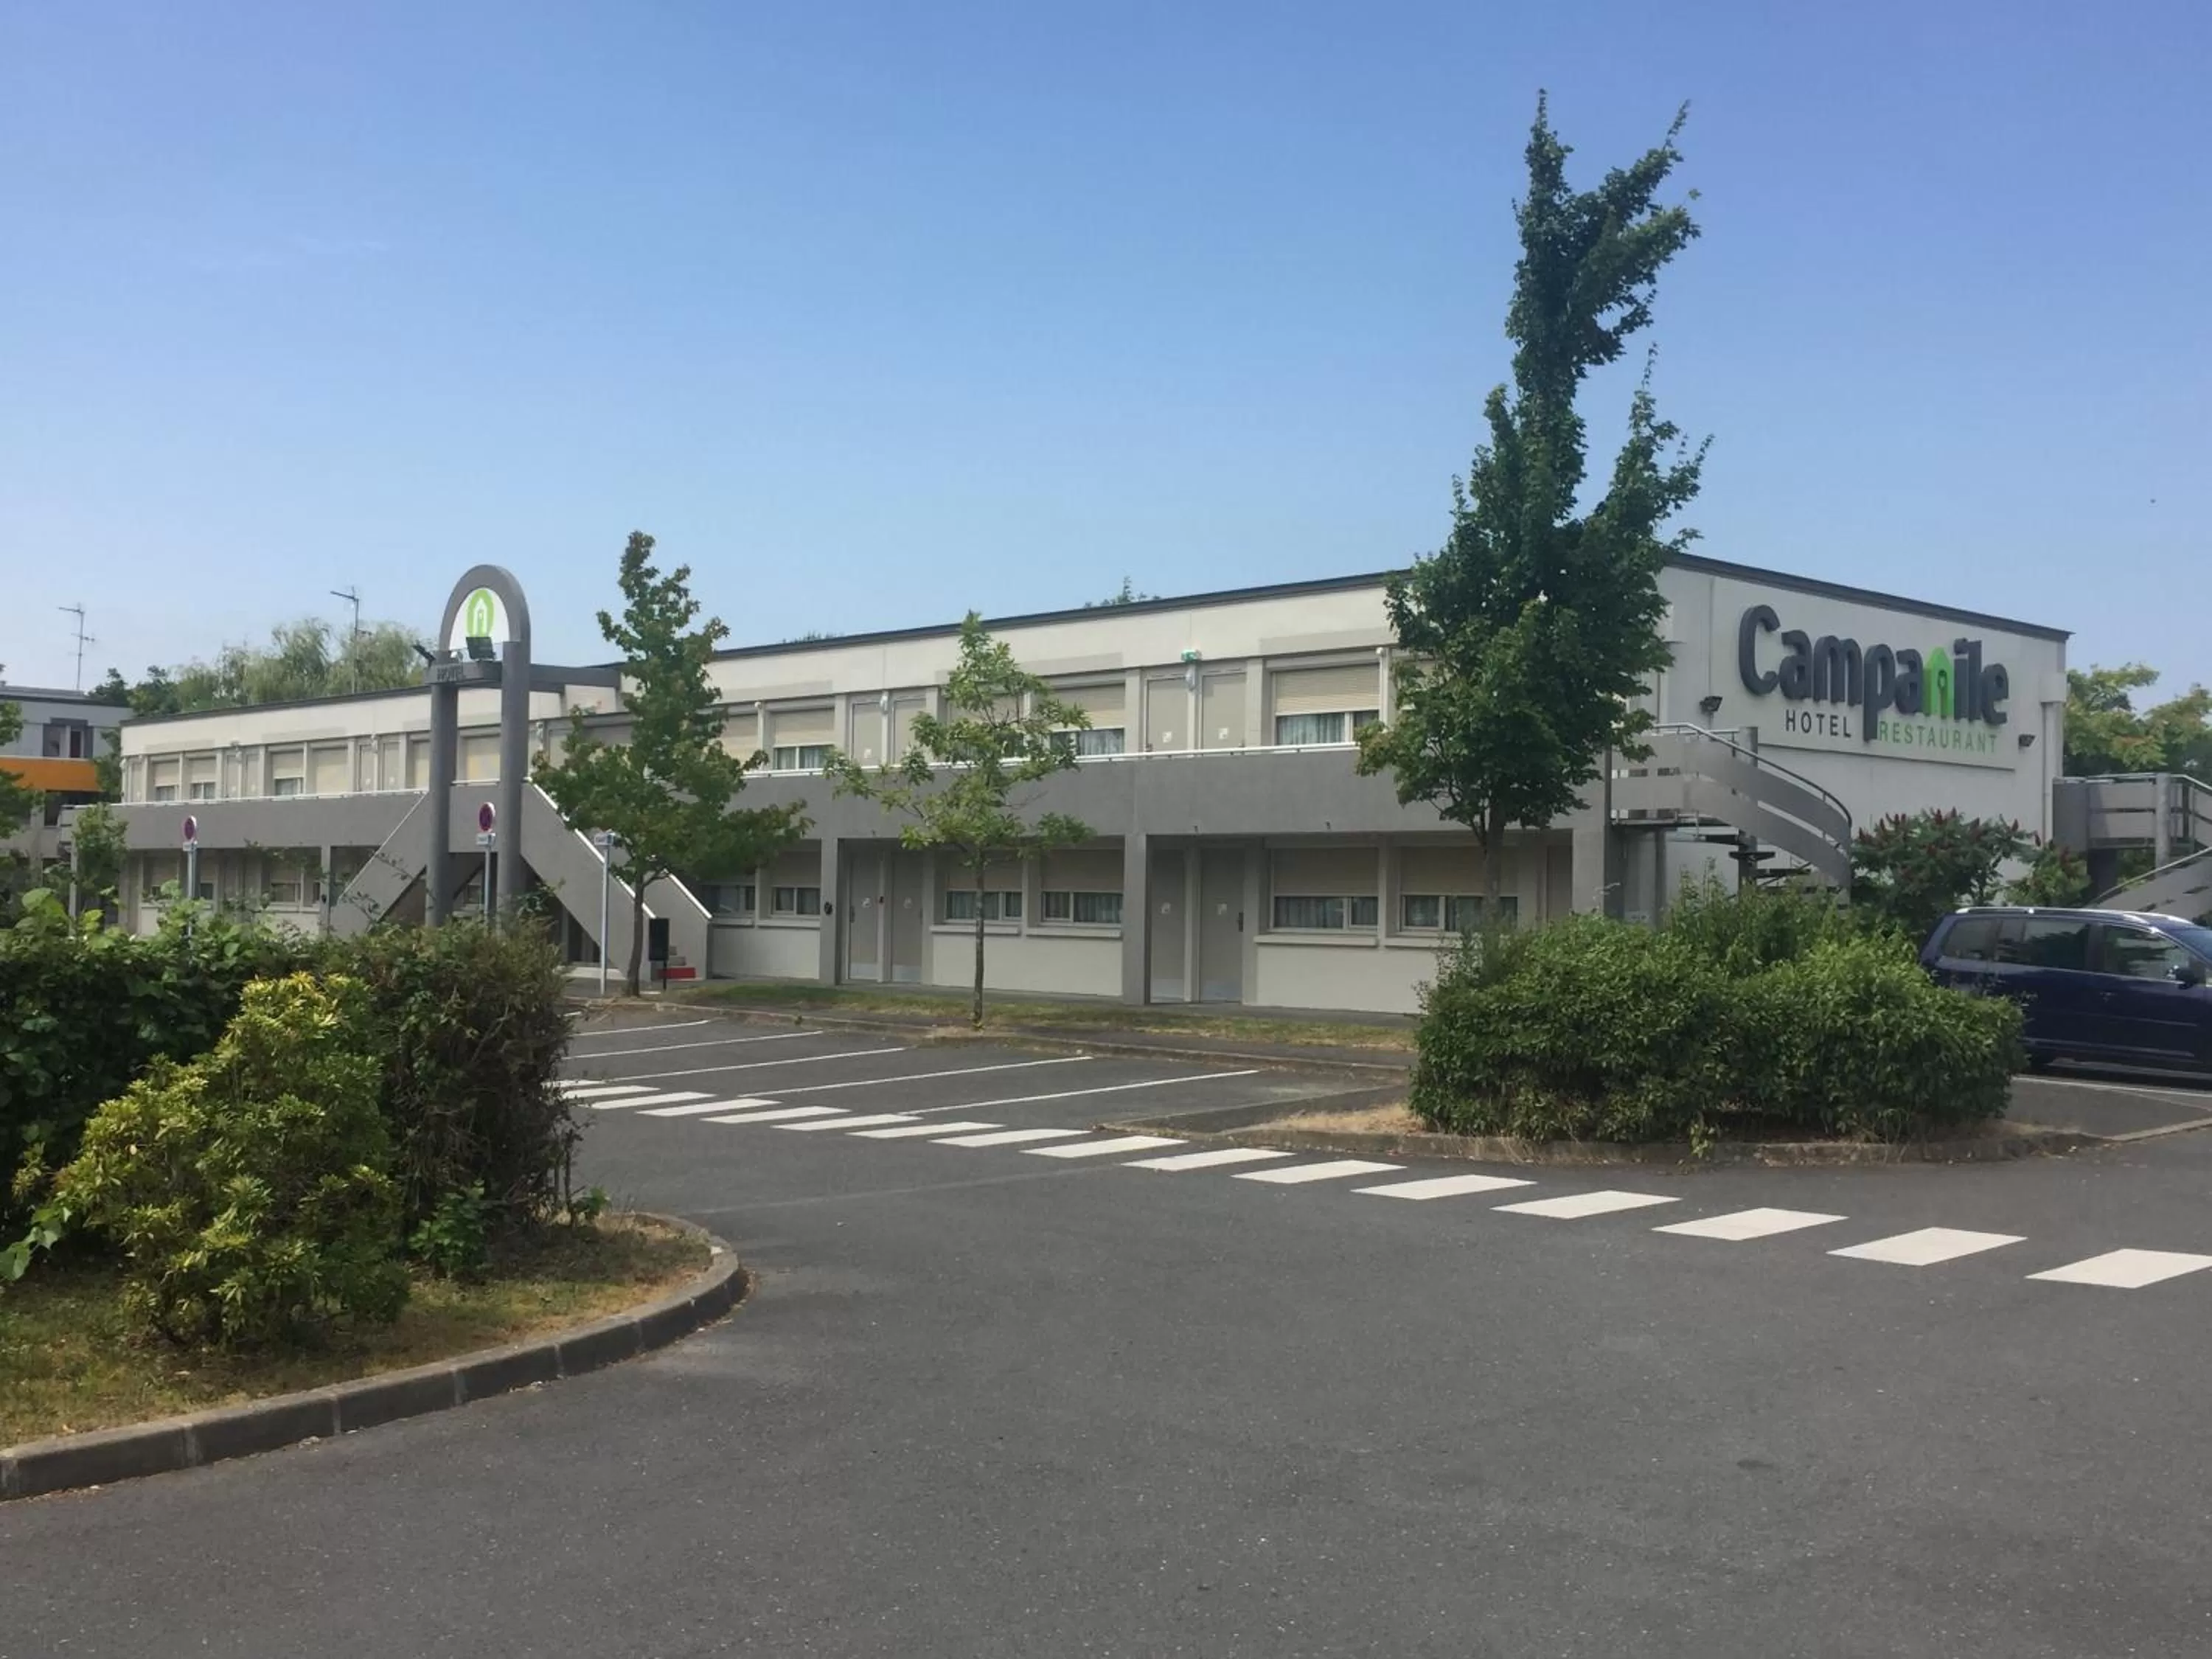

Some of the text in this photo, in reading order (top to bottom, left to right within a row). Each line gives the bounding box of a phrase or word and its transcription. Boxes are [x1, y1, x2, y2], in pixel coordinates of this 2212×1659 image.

[1739, 605, 2009, 742] Campanile
[1785, 709, 1997, 754] HOTEL RESTAURANT
